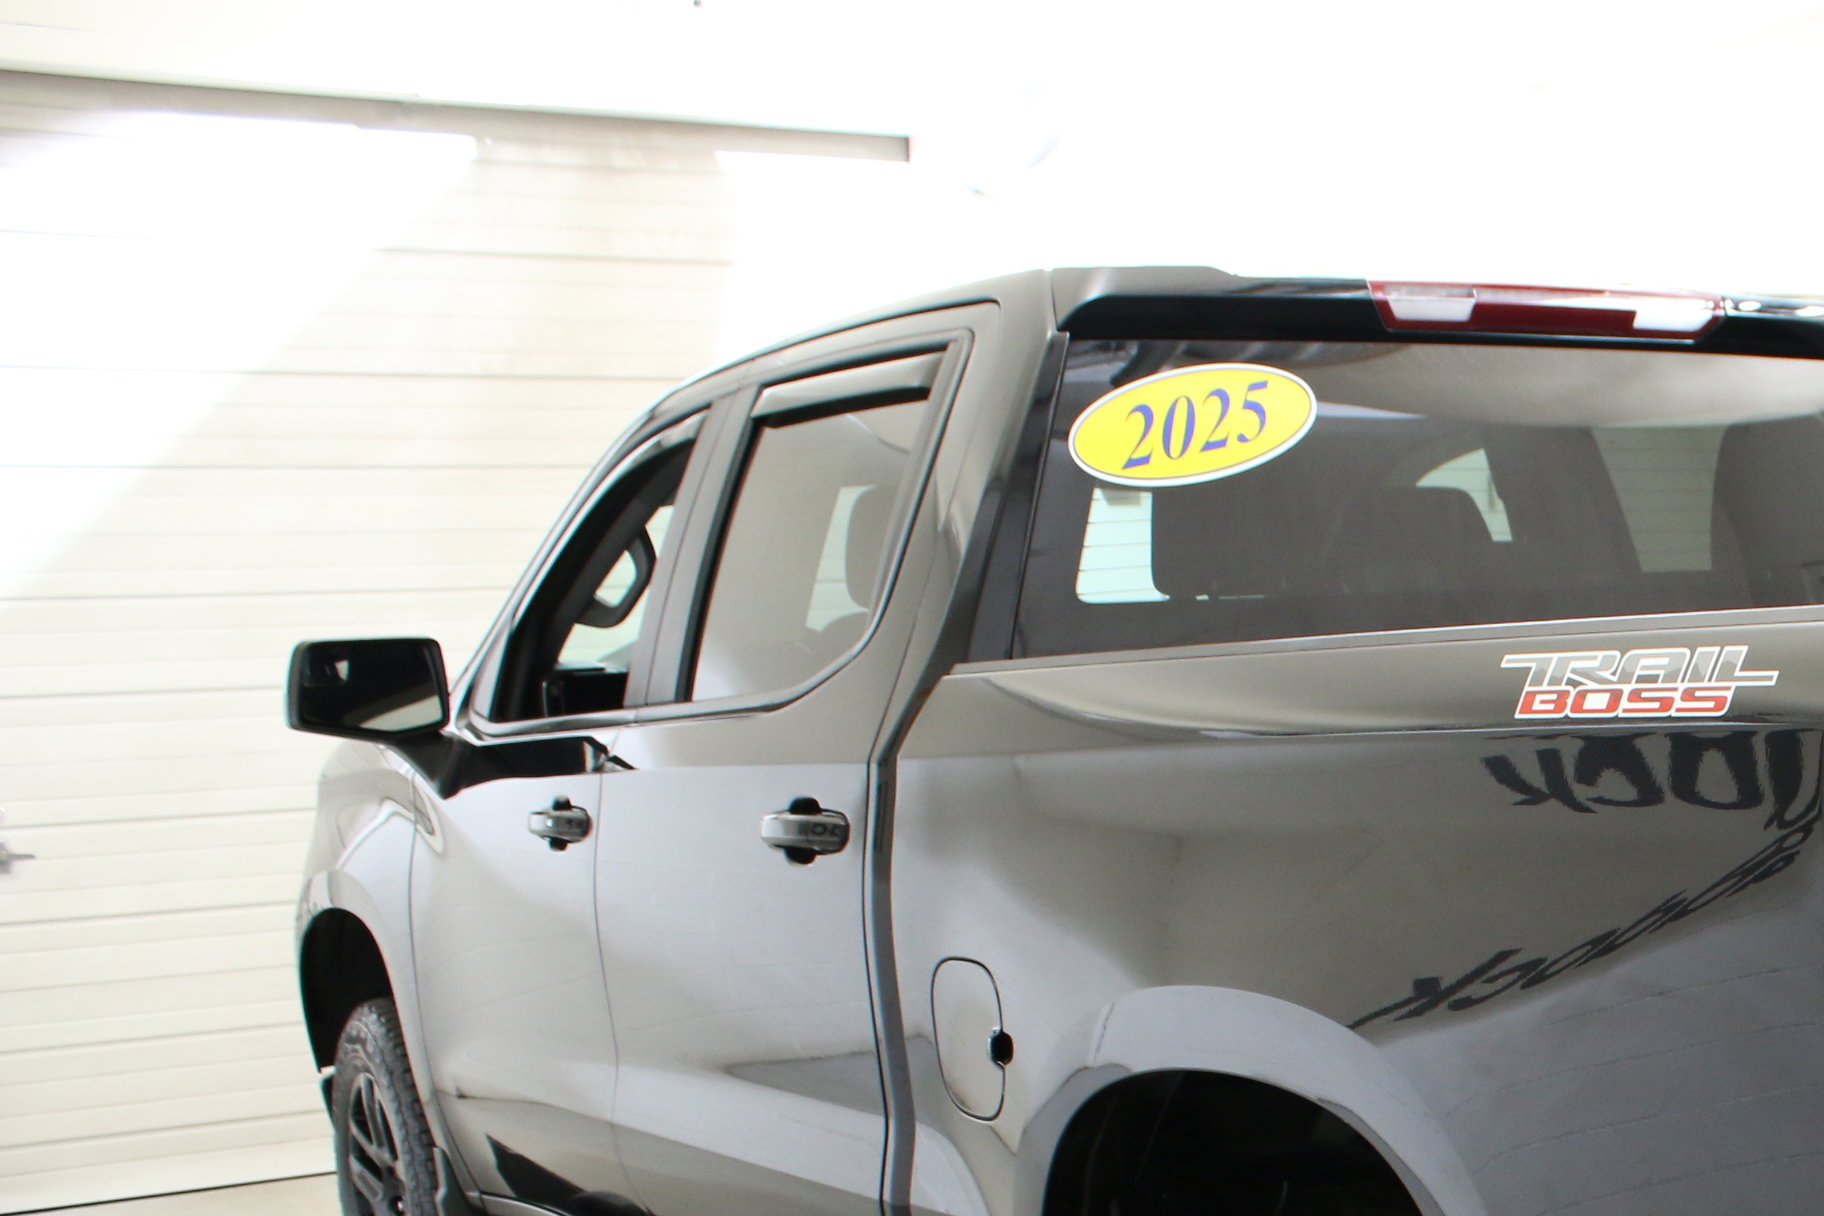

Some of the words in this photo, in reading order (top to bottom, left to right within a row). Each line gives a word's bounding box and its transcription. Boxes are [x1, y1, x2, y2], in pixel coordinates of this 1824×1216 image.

[1121, 380, 1268, 470] 2025
[1500, 645, 1779, 688] TRAIL
[1514, 684, 1736, 719] BOSS
